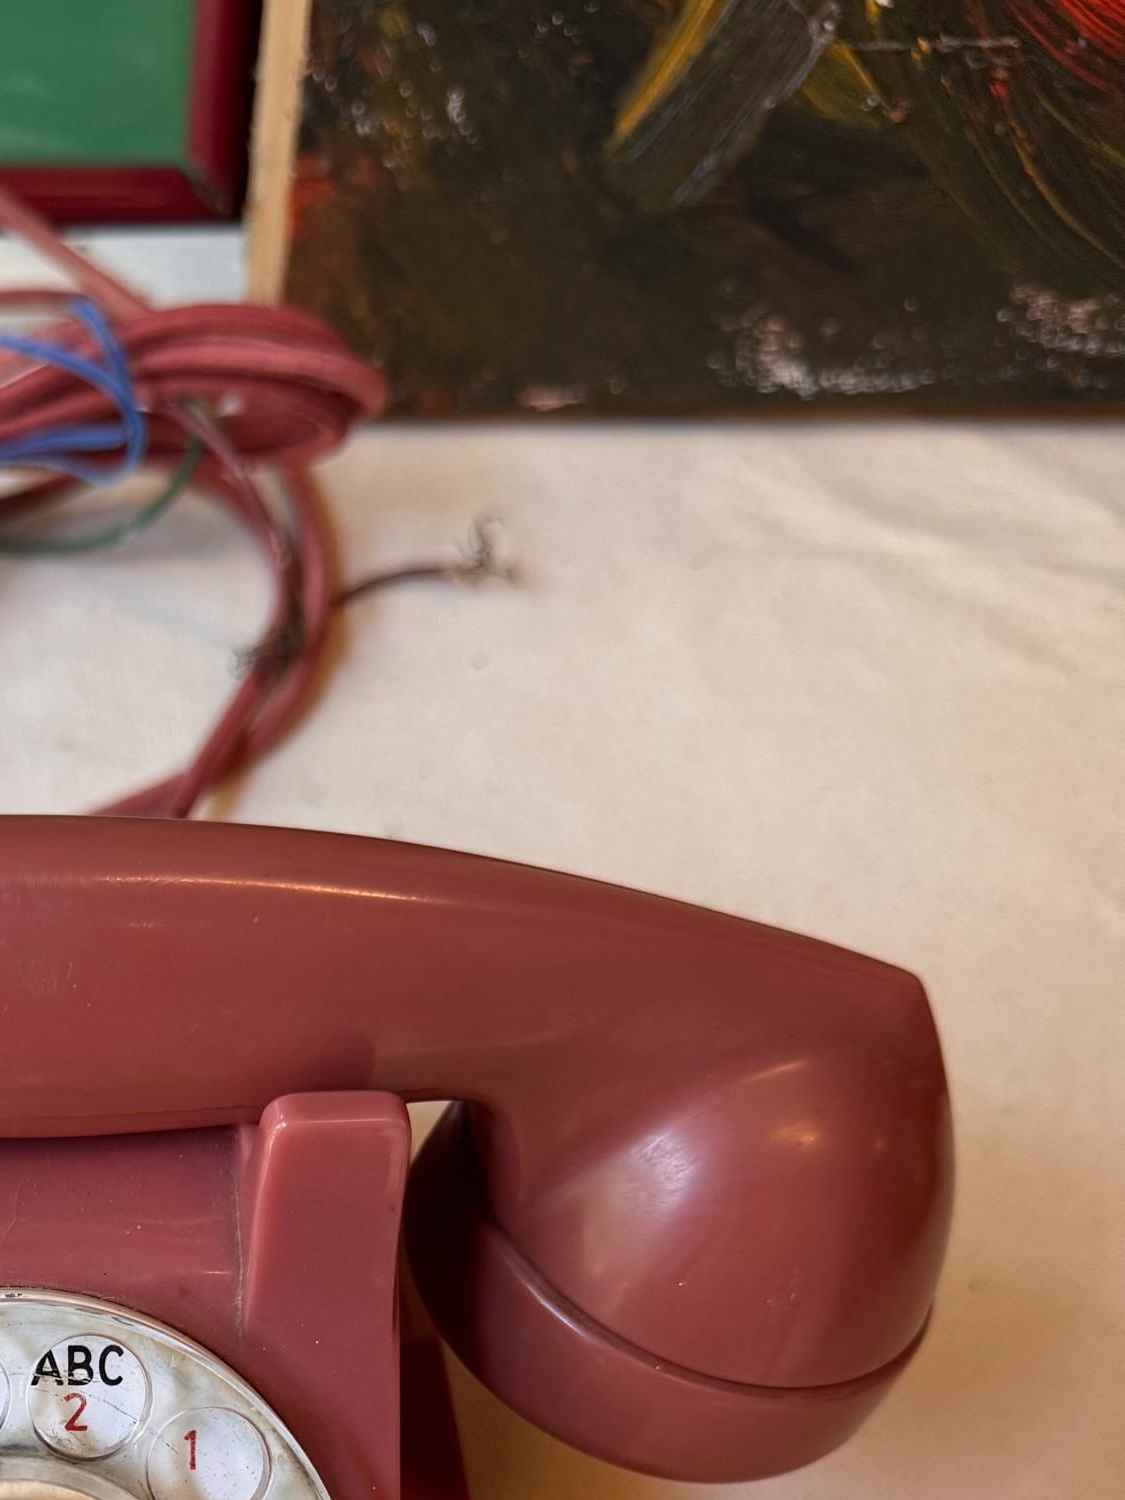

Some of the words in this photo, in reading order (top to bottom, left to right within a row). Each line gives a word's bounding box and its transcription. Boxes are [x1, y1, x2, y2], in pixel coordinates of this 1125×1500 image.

[31, 1345, 124, 1386] ABC
[64, 1393, 88, 1432] 2
[184, 1430, 197, 1470] 1
